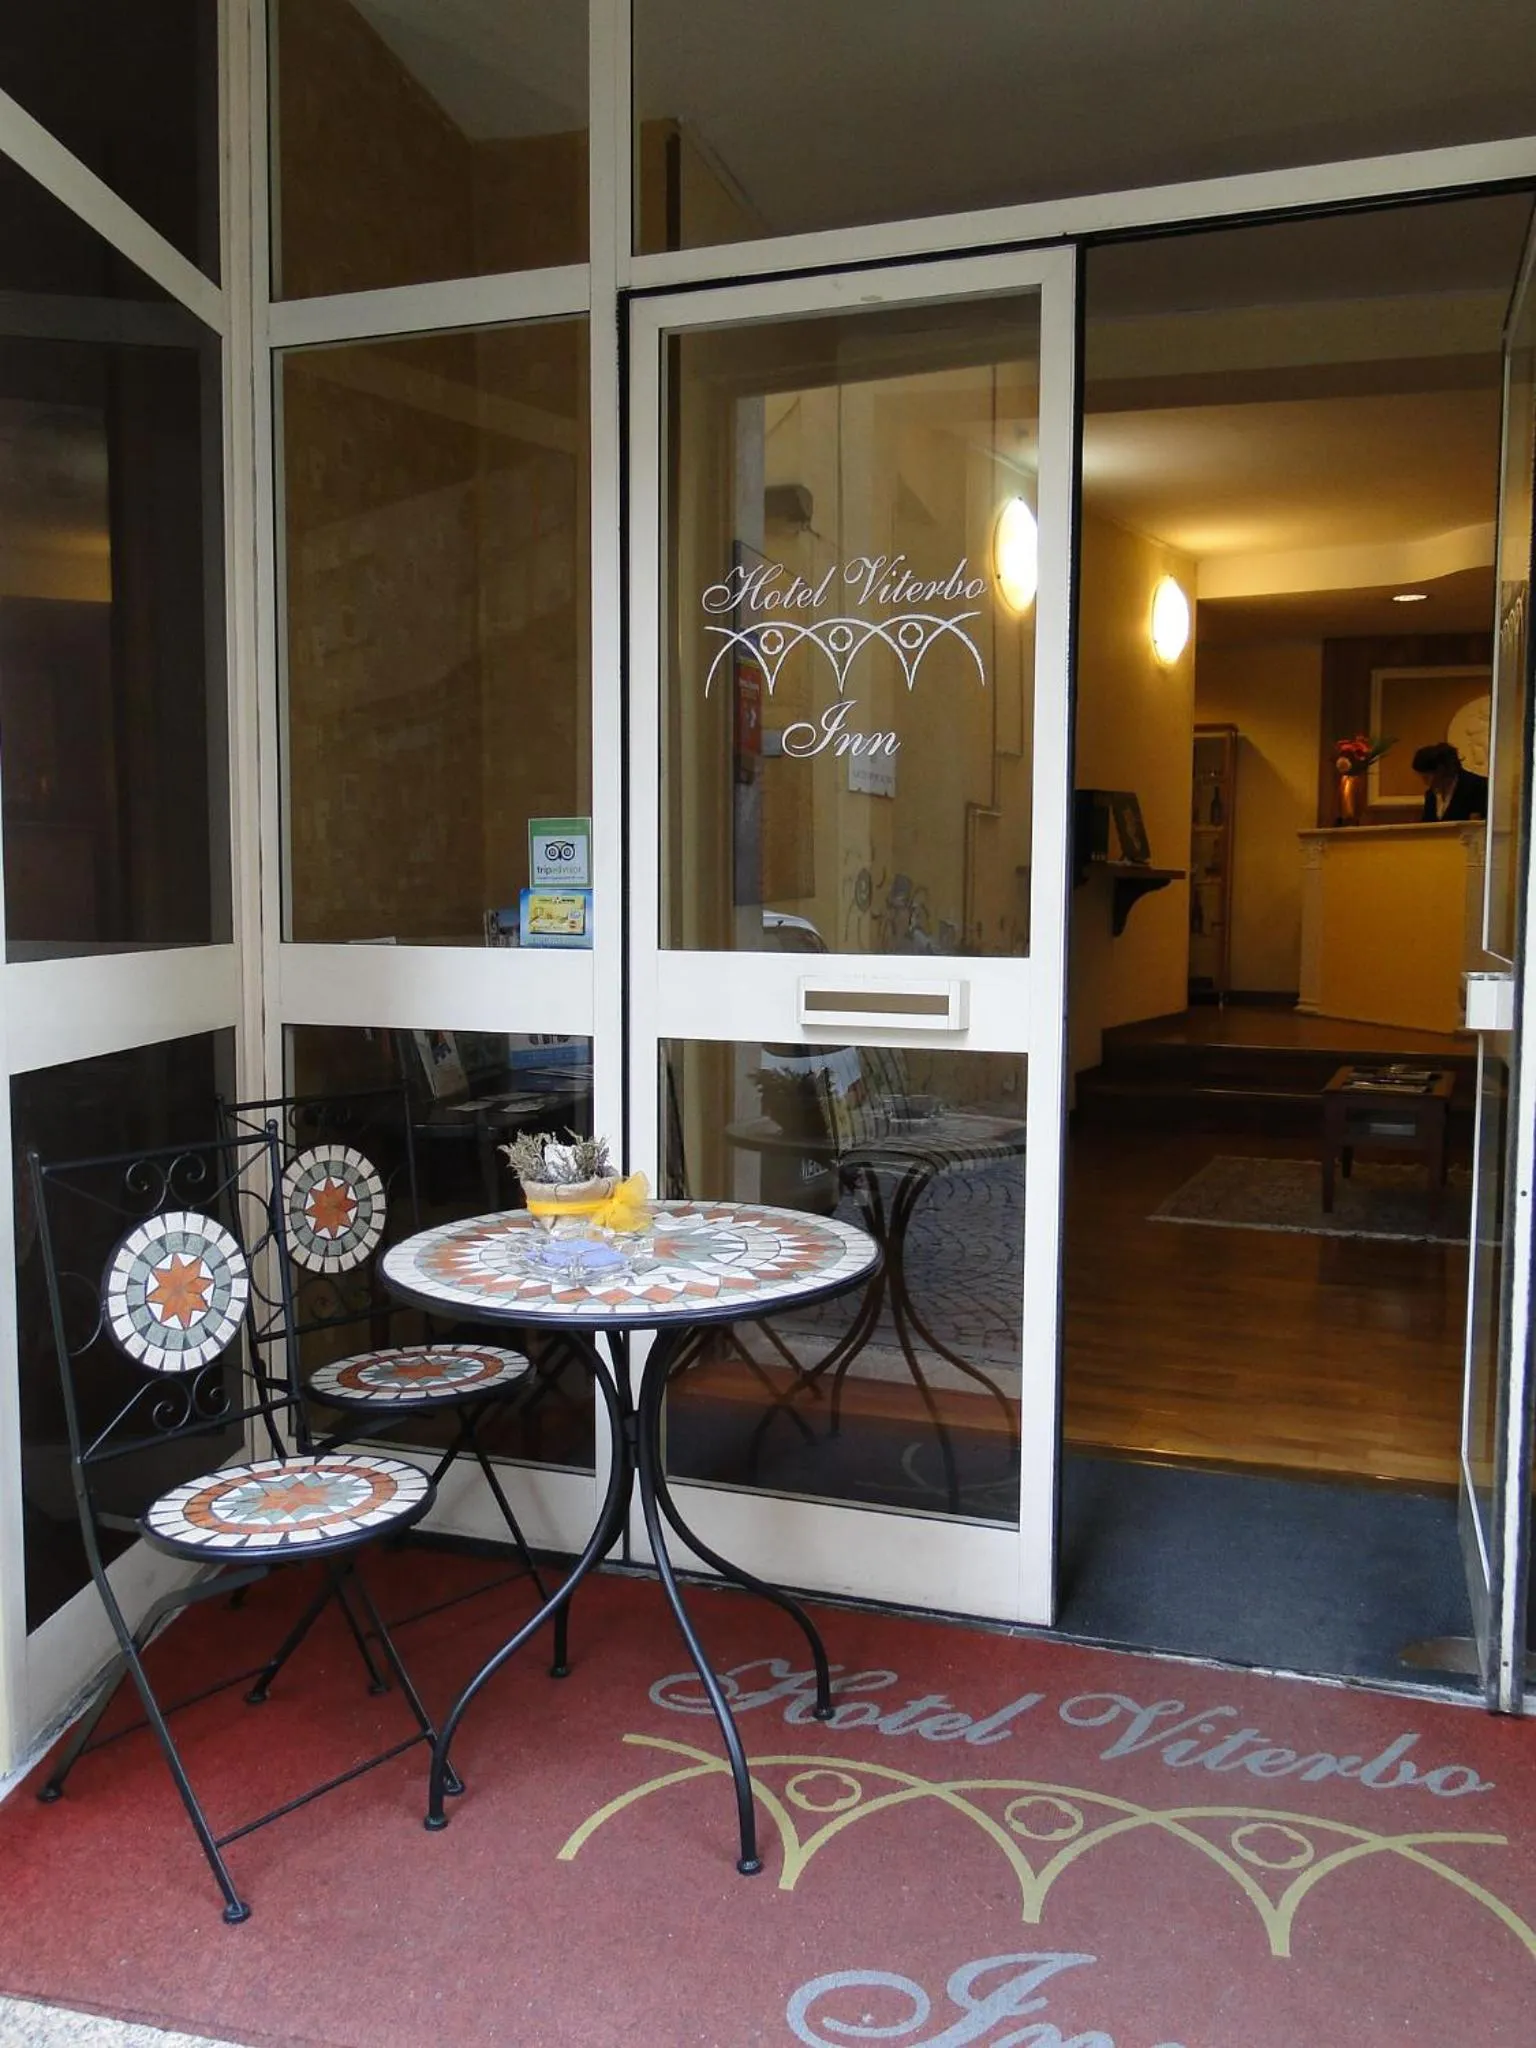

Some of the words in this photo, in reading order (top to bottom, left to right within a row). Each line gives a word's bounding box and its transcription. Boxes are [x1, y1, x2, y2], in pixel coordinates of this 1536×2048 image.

[702, 564, 836, 614] Hotel
[844, 555, 988, 605] Viterbo
[782, 700, 901, 758] Inn
[649, 1657, 1044, 1745] Hotel
[1059, 1693, 1495, 1797] Viterbo
